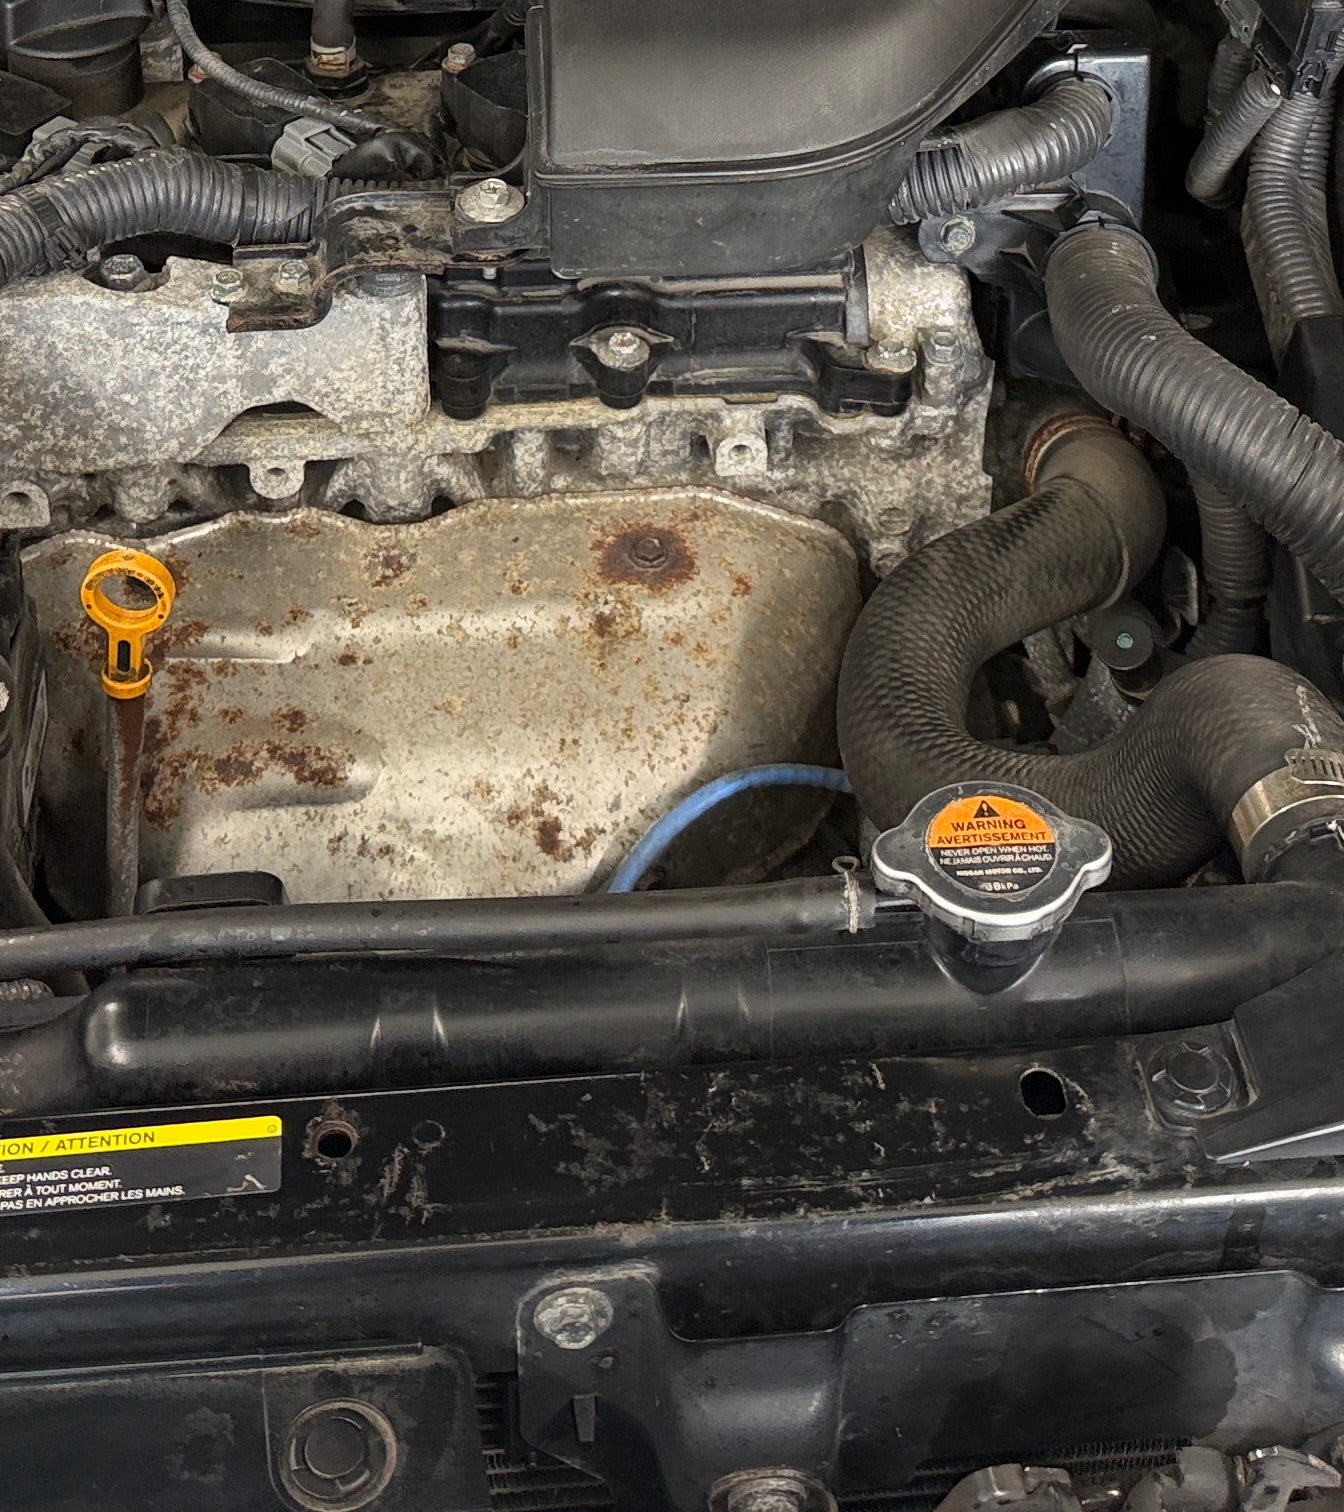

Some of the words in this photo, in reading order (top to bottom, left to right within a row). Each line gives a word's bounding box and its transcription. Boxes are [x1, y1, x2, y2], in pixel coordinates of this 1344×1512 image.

[951, 819, 1027, 832] WARNING
[936, 831, 1047, 845] AVERTISSEMENT
[940, 849, 970, 857] NEVER
[972, 847, 997, 855] OPEN
[997, 845, 1026, 853] WHEN
[1028, 845, 1049, 853] HOT.
[56, 1131, 155, 1152] ATTENTION
[27, 1170, 69, 1183] HANDS
[71, 1166, 112, 1179] CLEAR.
[24, 1184, 33, 1196] À
[35, 1183, 67, 1195] TOUT
[68, 1179, 123, 1192] MOMENT.
[0, 1199, 23, 1211] PAS
[26, 1197, 42, 1209] EN
[44, 1191, 119, 1207] APPROCHER
[121, 1188, 143, 1200] LES
[145, 1185, 186, 1198] MAINS.
